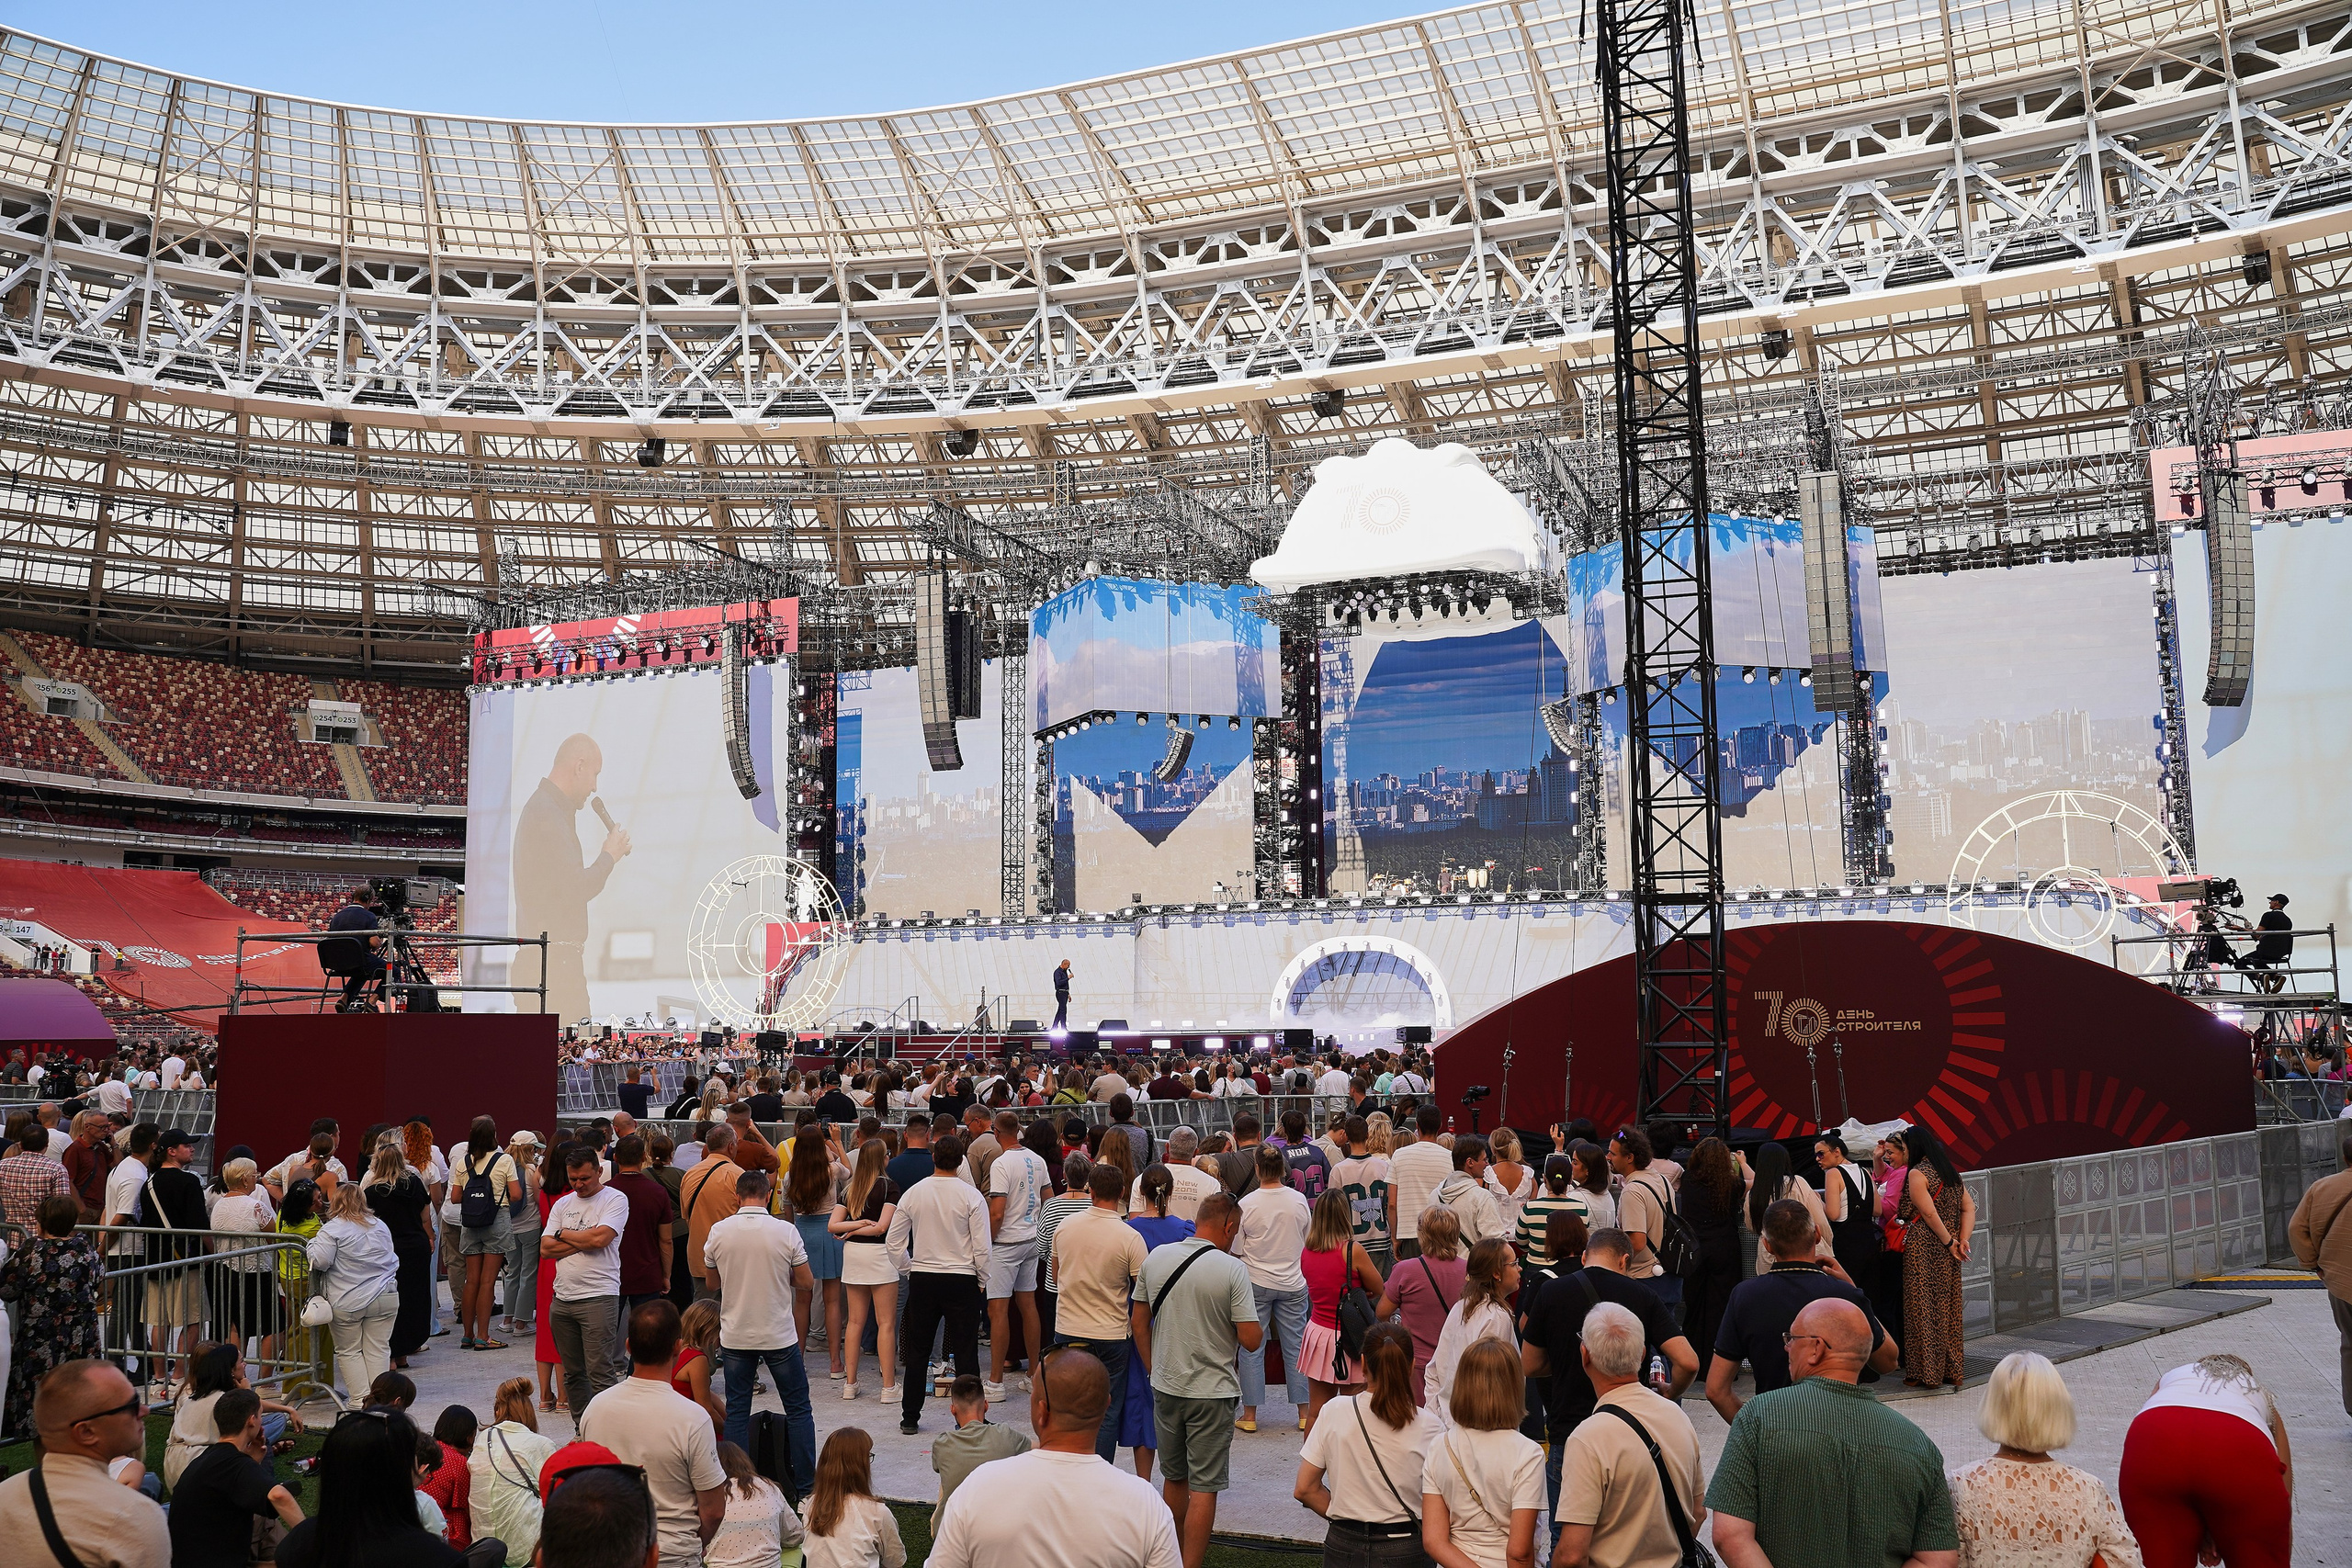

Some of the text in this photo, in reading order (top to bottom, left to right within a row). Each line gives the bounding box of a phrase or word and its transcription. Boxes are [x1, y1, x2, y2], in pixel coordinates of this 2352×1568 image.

[37, 684, 76, 695] 256 255
[1837, 1010, 1875, 1020] ДЕНЬ
[1837, 1021, 1922, 1032] СТРОИТЕЛЯ
[1287, 1146, 1310, 1158] NDN
[1176, 1179, 1198, 1188] New
